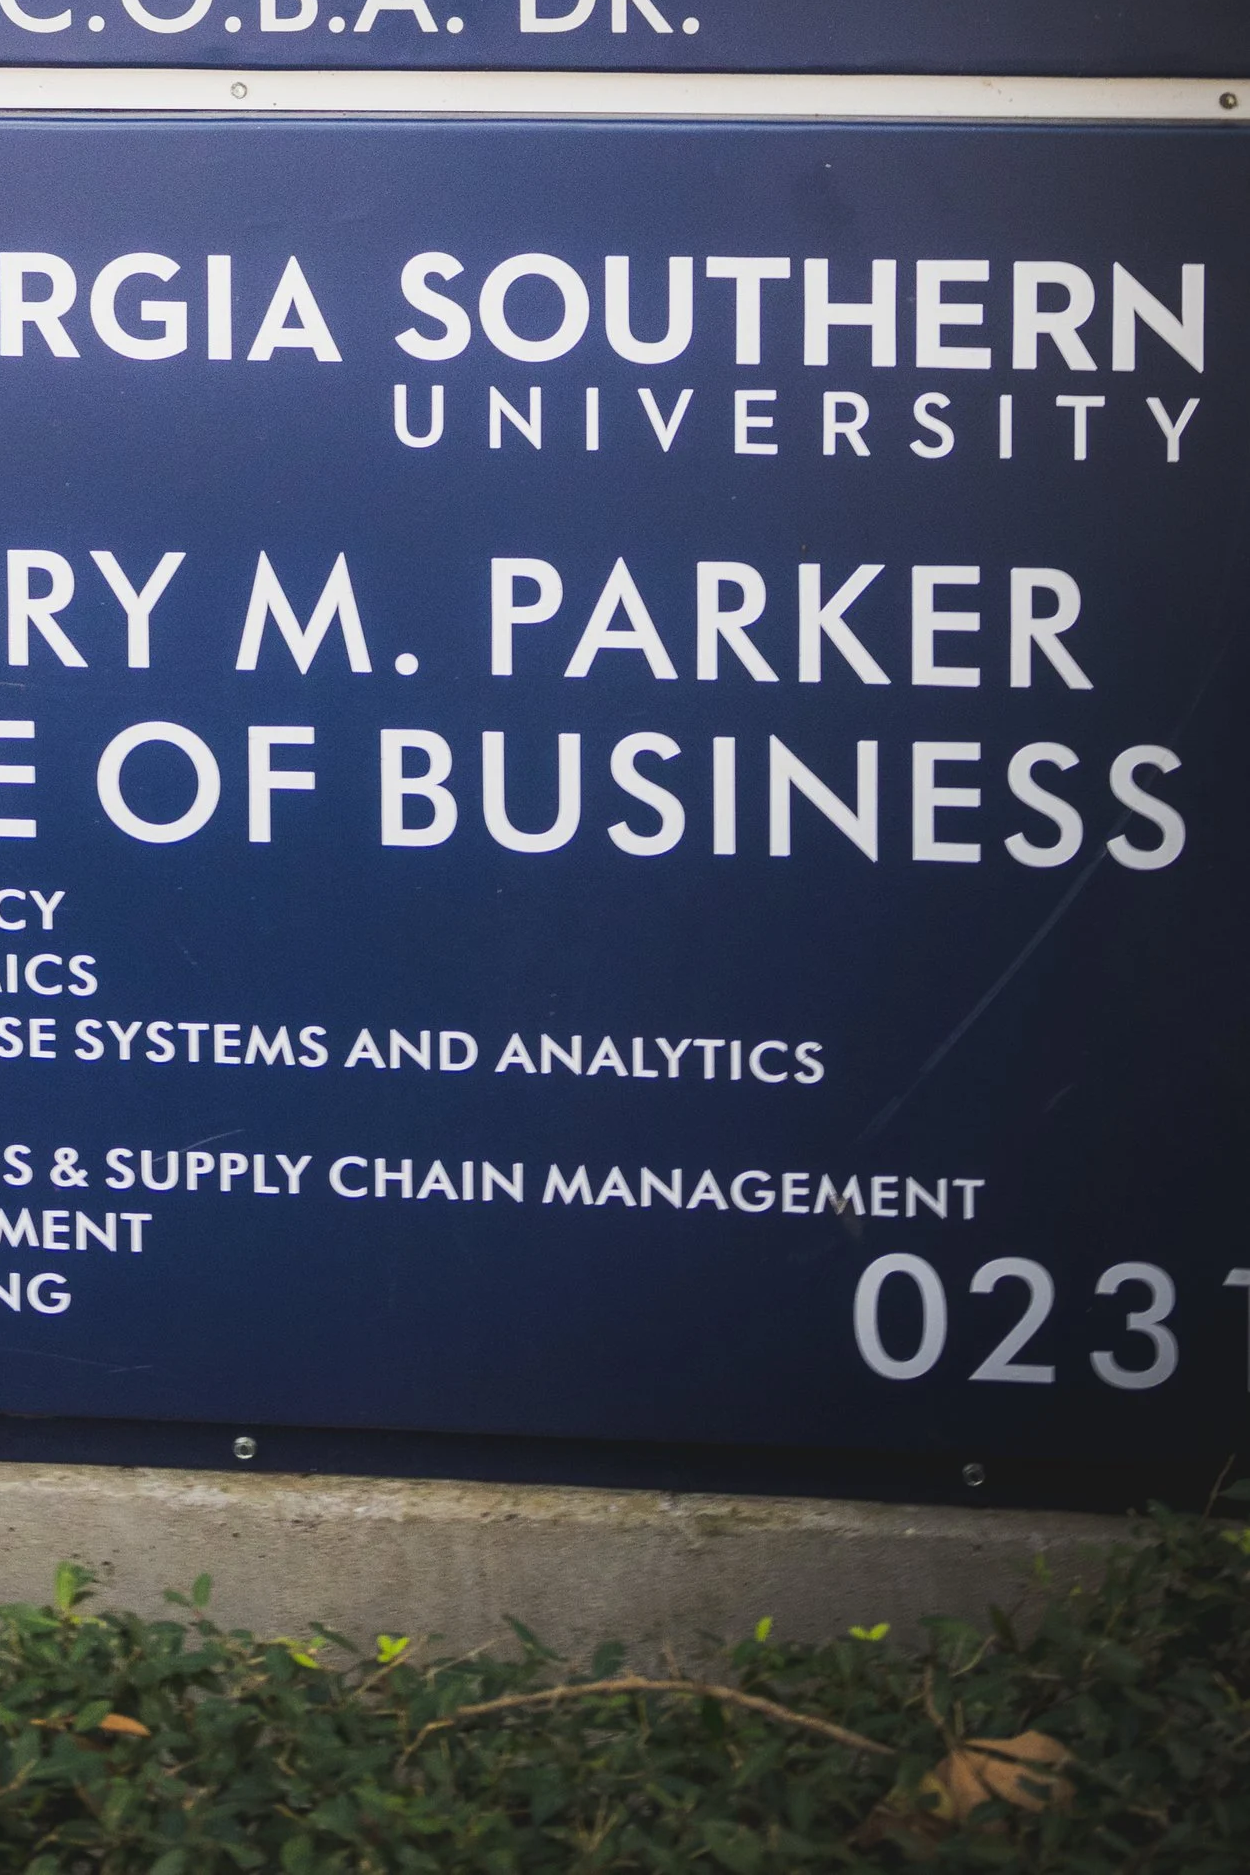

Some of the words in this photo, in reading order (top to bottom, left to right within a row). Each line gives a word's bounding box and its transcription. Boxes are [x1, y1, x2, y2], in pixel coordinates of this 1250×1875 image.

[394, 251, 1205, 374] SOUTHERN
[393, 383, 1200, 463] UNIVERSITY
[235, 550, 419, 676] M.
[490, 556, 1094, 690] PARKER
[96, 720, 316, 844] OF
[380, 728, 1186, 870] BUSINESS
[74, 1018, 329, 1068] SYSTEMS
[343, 1028, 479, 1071] AND
[494, 1032, 825, 1084] ANALYTICS
[49, 1147, 89, 1188] &
[105, 1147, 313, 1195] SUPPLY
[329, 1155, 524, 1203] CHAIN
[541, 1163, 985, 1220] MANAGEMENT
